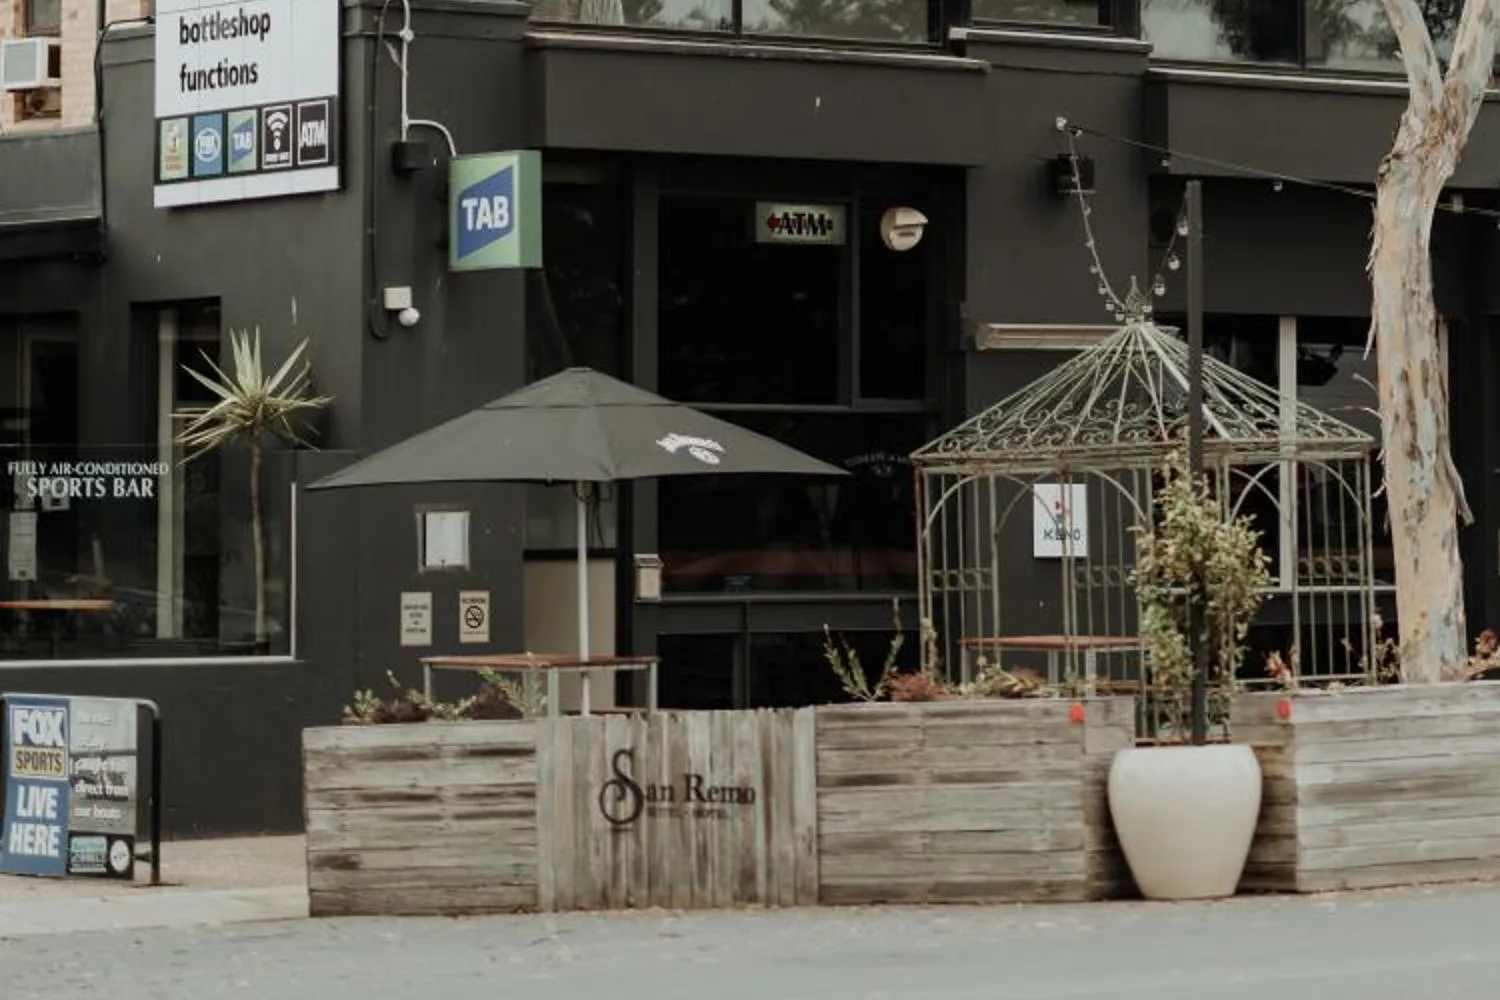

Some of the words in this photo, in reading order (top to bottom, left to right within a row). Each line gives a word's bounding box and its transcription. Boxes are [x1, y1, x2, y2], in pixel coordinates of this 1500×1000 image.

[179, 7, 271, 45] bottleshop
[179, 57, 258, 92] functions
[301, 119, 328, 148] ATM
[461, 195, 509, 232] TAB
[780, 212, 826, 236] ATM
[8, 461, 46, 475] FULLY
[50, 461, 169, 475] AIR-CONDITIONED
[27, 476, 106, 497] SPORTS
[113, 477, 154, 497] BAR
[13, 709, 65, 746] FOX
[15, 750, 63, 774] SPORTS
[16, 785, 58, 819] LIVE
[598, 746, 673, 824] San
[683, 773, 756, 805] Remo
[8, 822, 61, 857] HERE
